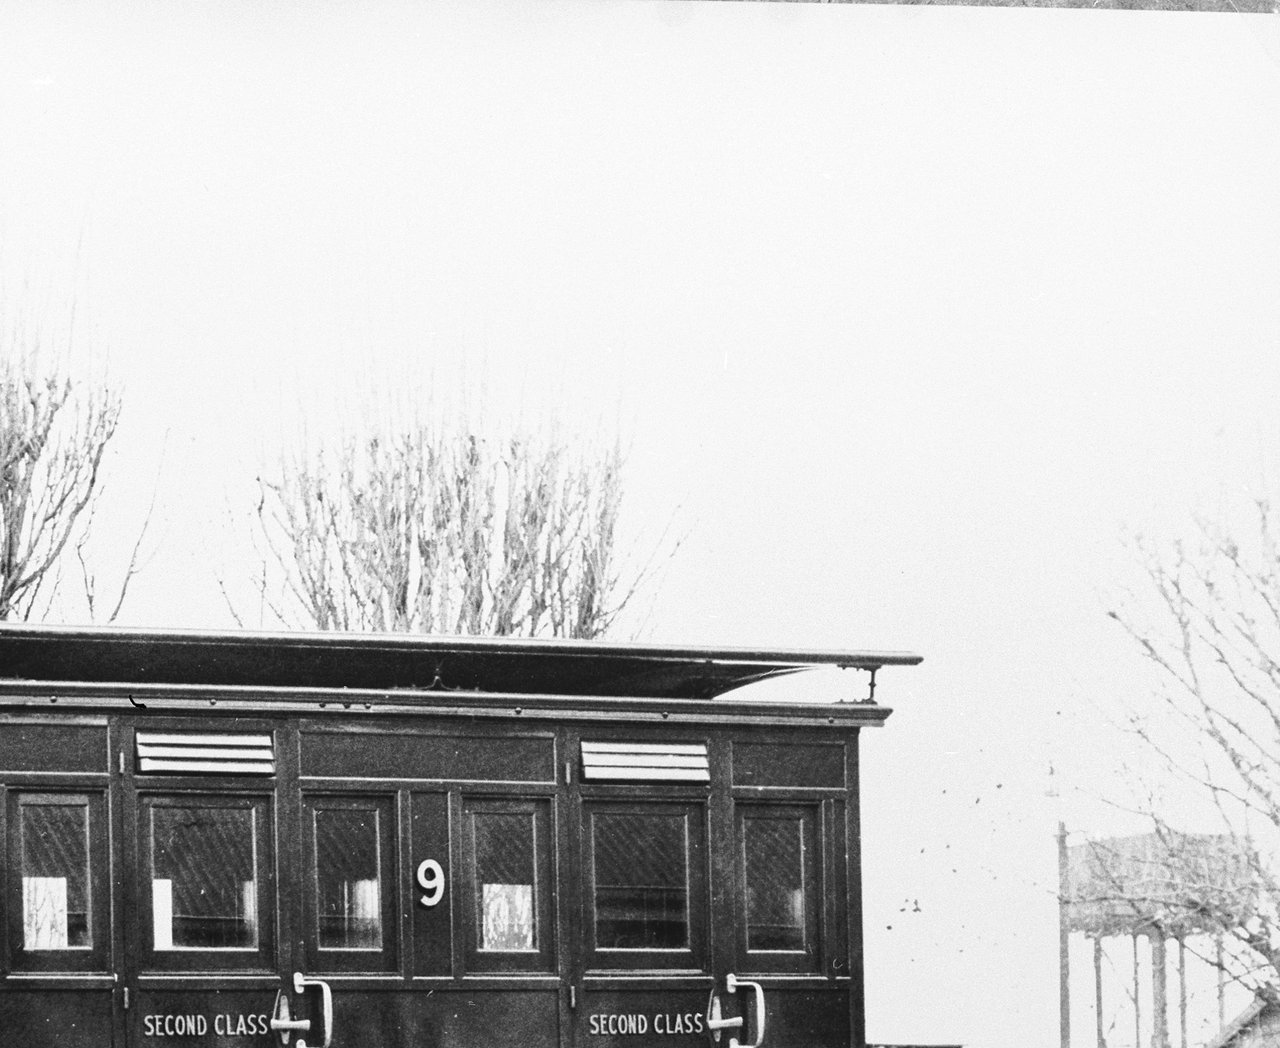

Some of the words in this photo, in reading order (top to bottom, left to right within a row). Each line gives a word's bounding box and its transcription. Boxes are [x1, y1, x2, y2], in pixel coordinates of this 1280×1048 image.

[416, 858, 445, 907] 9
[144, 1014, 208, 1036] SECOND
[214, 1013, 269, 1036] CLASS
[589, 1013, 648, 1035] SECOND
[654, 1012, 704, 1034] CLASS
